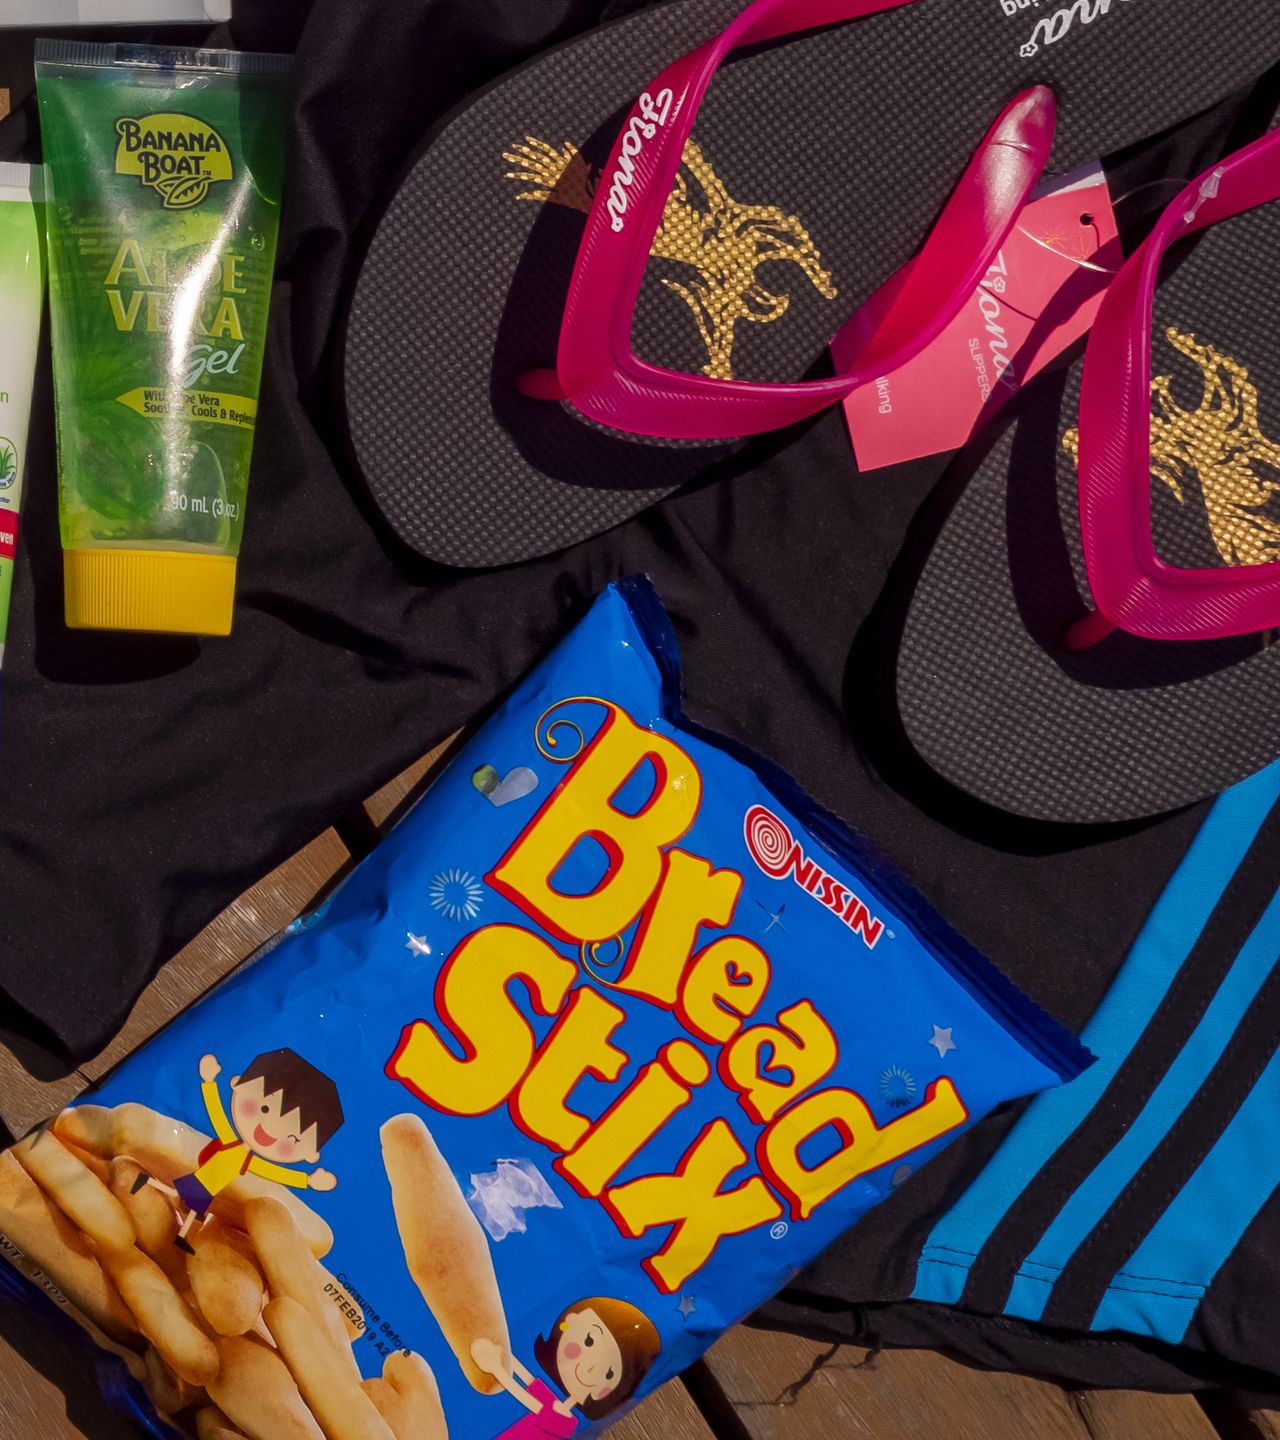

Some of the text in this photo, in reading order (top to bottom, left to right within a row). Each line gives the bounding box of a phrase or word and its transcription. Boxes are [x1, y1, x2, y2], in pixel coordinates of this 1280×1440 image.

[117, 120, 222, 152] BANANA
[137, 151, 206, 184] BOAT
[607, 88, 673, 233] Fiona
[184, 343, 246, 389] Gel
[968, 337, 991, 403] SLIPPERS
[191, 406, 218, 419] Cools
[220, 409, 226, 419] &
[198, 393, 221, 407] Vera
[171, 494, 188, 511] 90
[191, 496, 209, 514] mL
[791, 840, 886, 950] NISSIN
[484, 696, 970, 1222] Bread
[384, 922, 787, 1295] Stix
[323, 1283, 390, 1357] 07FEB2019 A2
[335, 1272, 412, 1358] Consume Before
